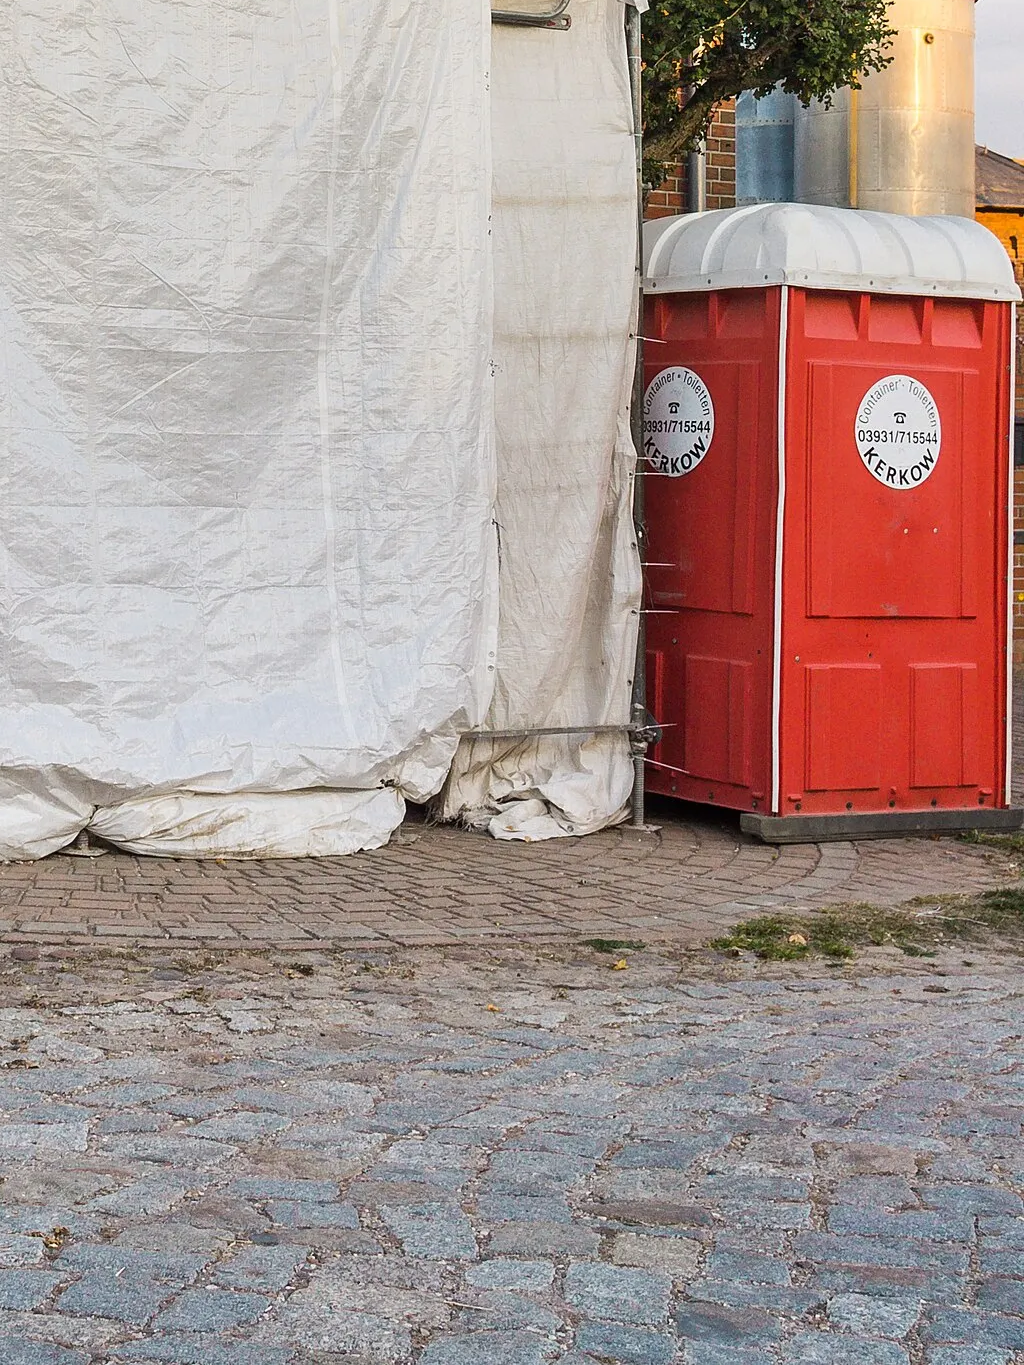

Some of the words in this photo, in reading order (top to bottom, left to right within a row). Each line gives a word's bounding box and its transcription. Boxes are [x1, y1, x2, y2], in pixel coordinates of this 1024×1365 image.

[683, 371, 710, 416] Toiletten
[859, 380, 900, 425] Container
[908, 380, 937, 428] Toiletten
[644, 436, 706, 474] KERKOW
[858, 429, 938, 444] 03931/715544
[863, 447, 935, 485] KERKOW
